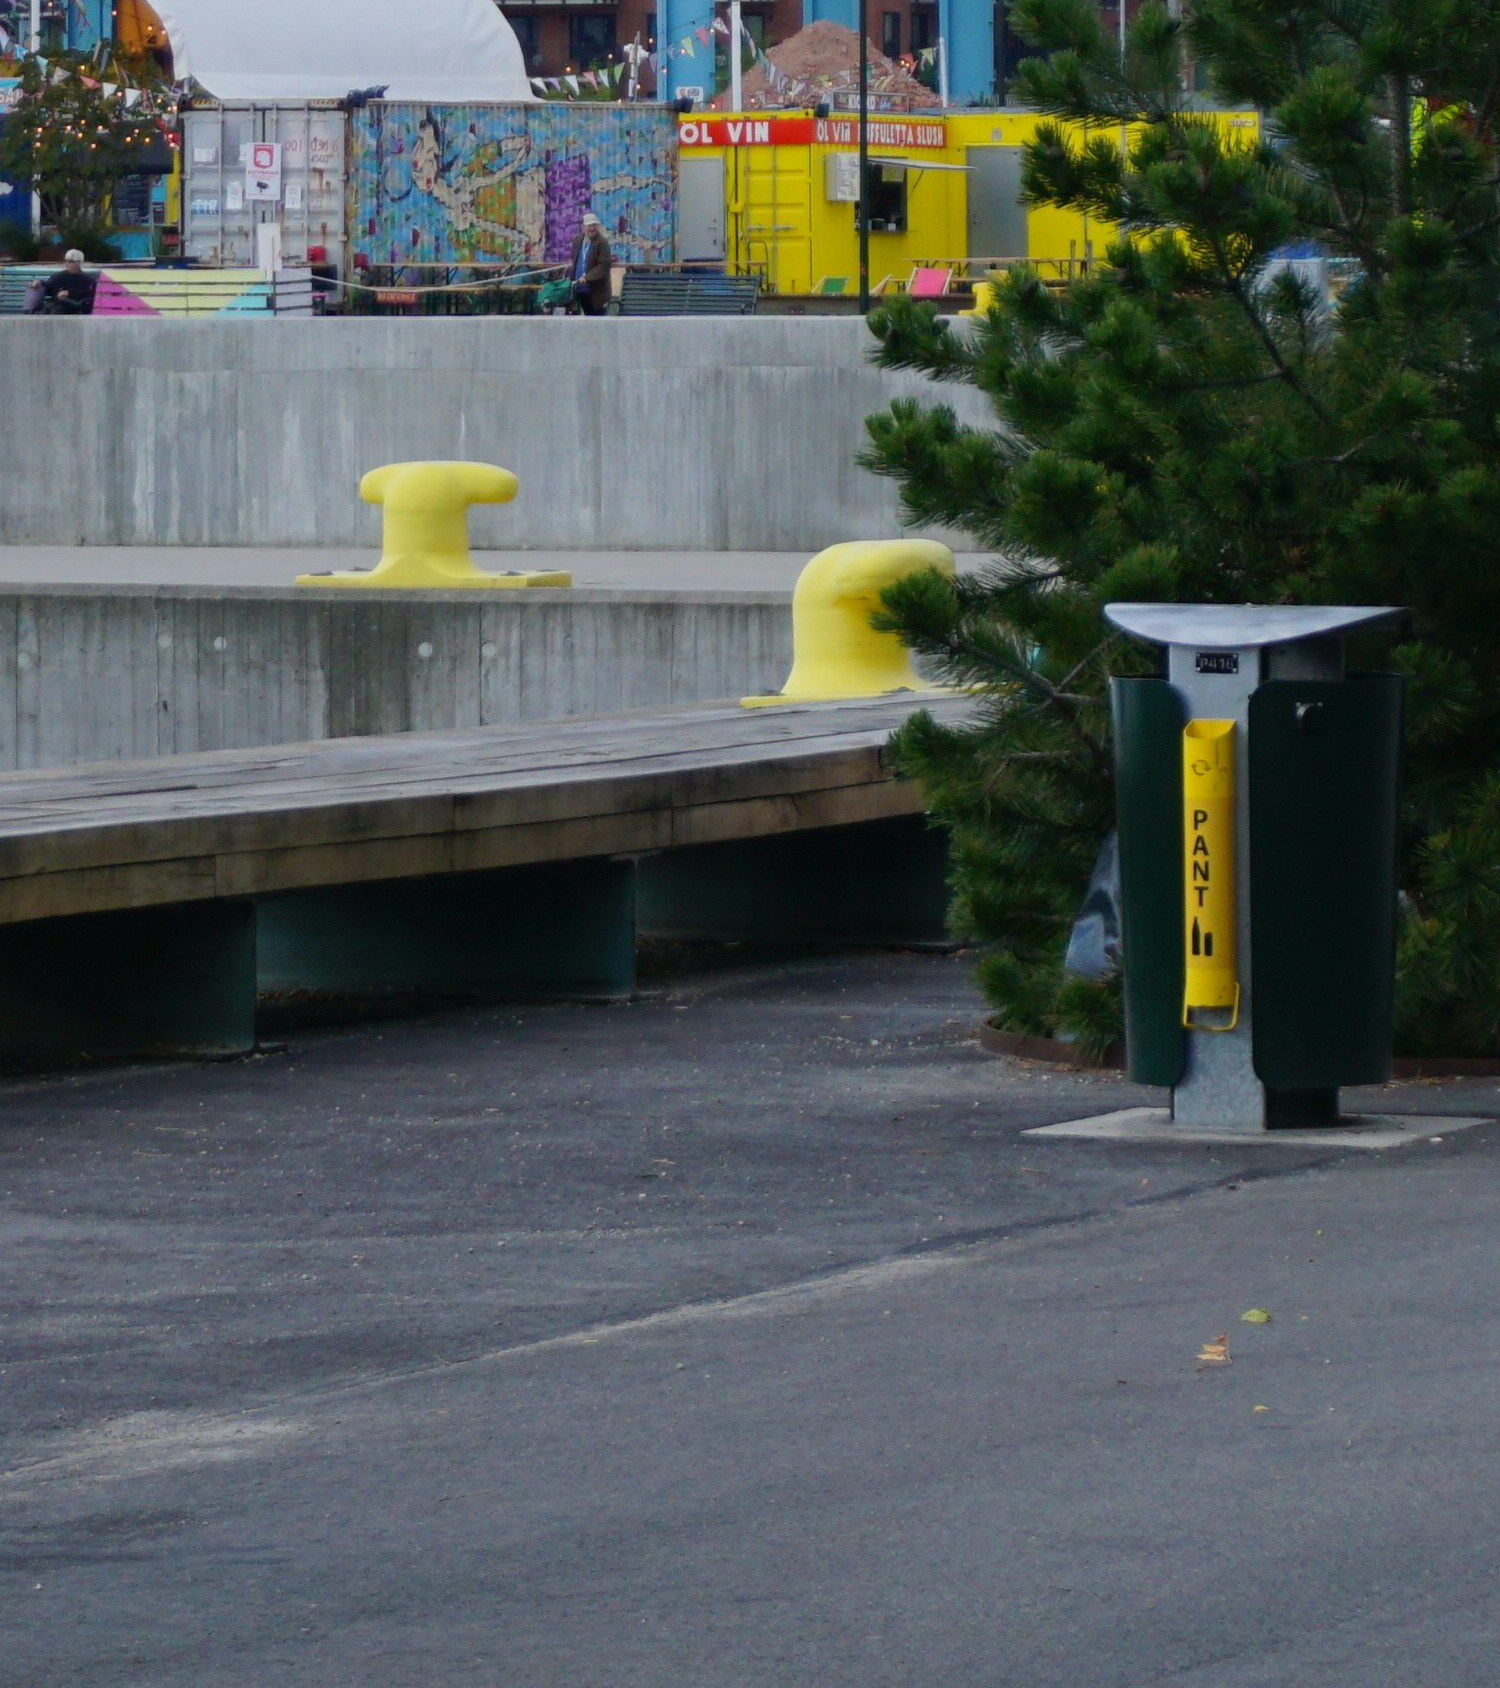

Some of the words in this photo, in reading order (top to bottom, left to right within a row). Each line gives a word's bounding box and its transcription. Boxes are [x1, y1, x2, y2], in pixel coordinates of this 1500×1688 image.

[679, 121, 712, 144] ÖL
[727, 120, 770, 144] VIN
[816, 120, 830, 142] ÖL
[857, 123, 914, 145] FFULETTA
[916, 125, 944, 147] SLUSH
[1193, 809, 1210, 907] PANT
